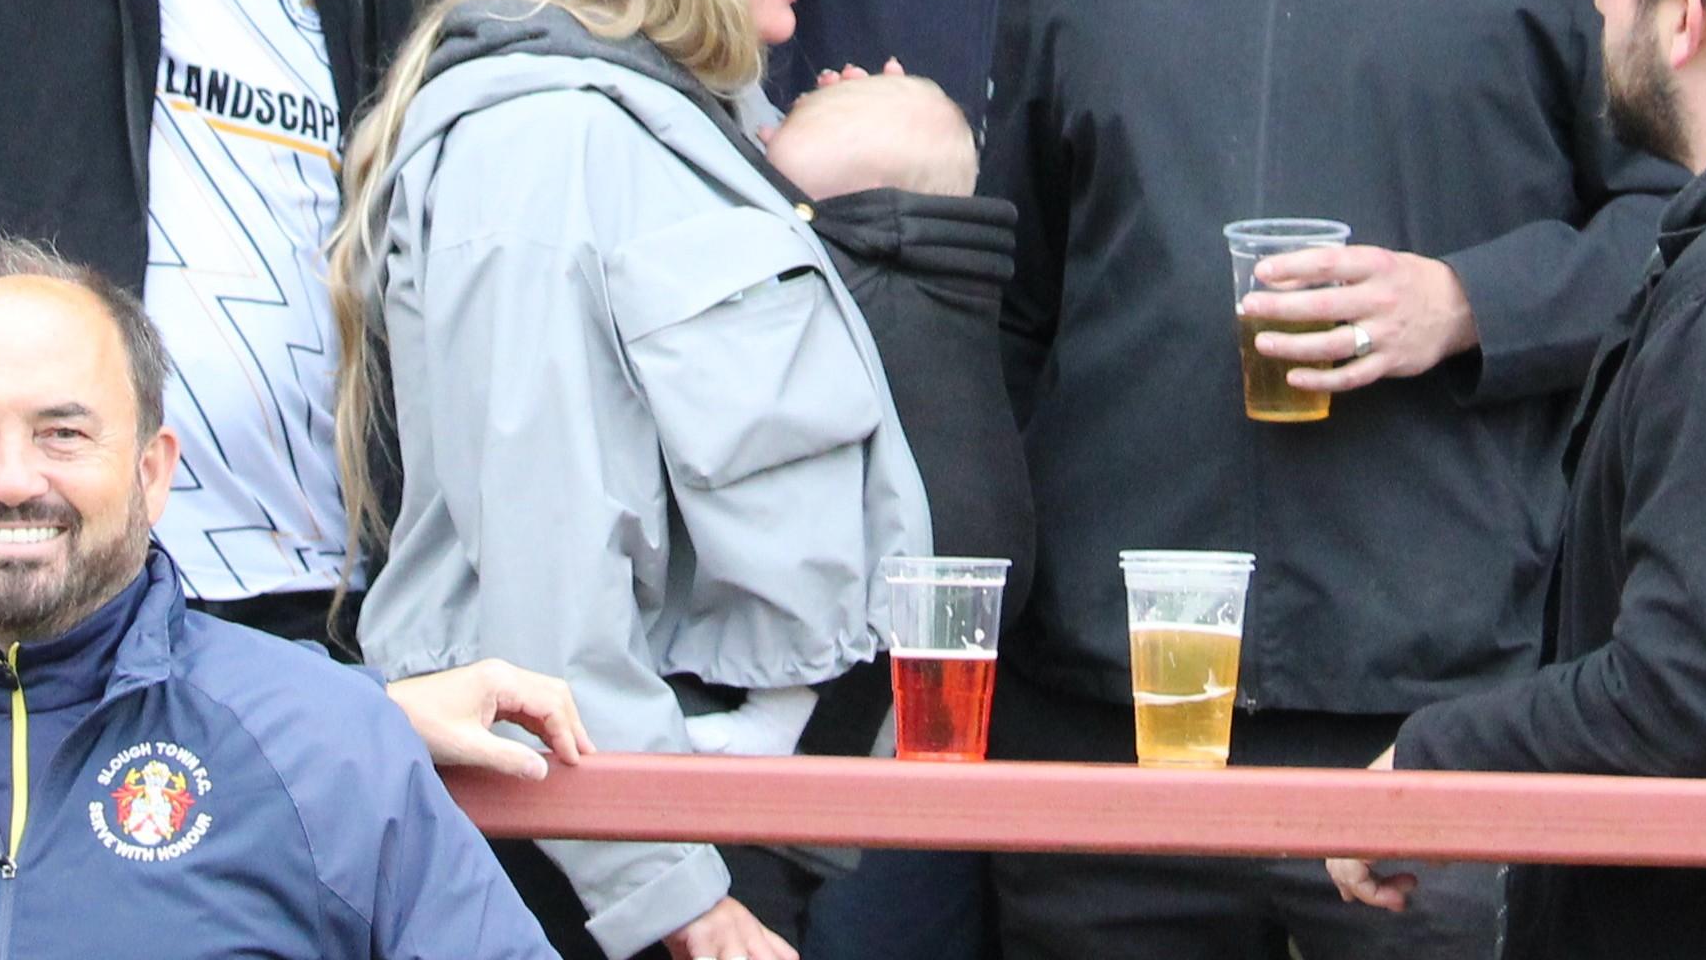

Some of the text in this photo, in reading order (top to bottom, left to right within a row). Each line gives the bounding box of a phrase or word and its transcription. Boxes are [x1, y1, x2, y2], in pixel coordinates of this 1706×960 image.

[165, 56, 343, 155] LANDSCAP
[97, 742, 152, 786] SLOUGH
[155, 741, 200, 771] TOWN
[88, 801, 213, 862] SERVE WITH HONOUR
